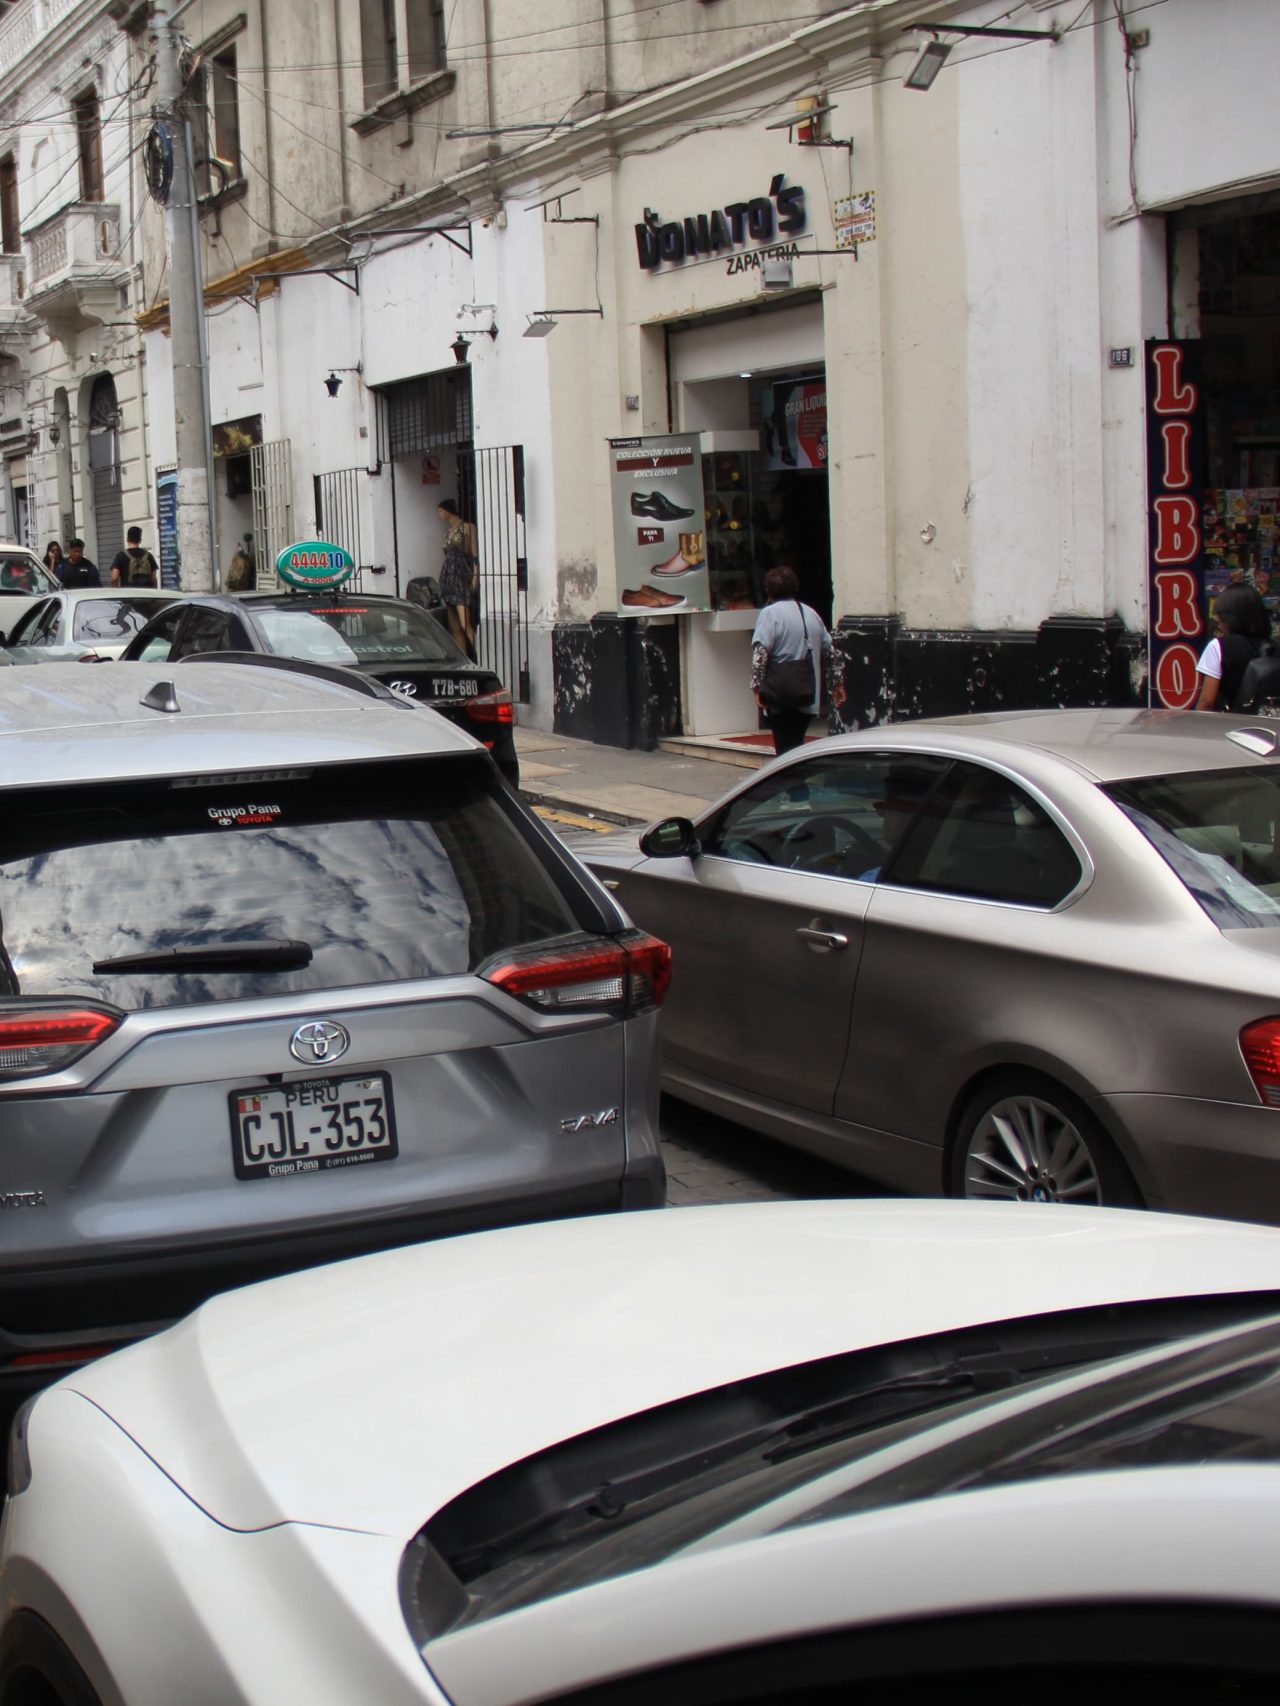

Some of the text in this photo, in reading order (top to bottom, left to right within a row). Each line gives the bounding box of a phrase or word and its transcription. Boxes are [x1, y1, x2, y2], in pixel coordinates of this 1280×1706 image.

[1112, 350, 1128, 361] 106
[663, 446, 692, 457] NUEVA
[652, 457, 659, 467] Y
[634, 468, 678, 478] EXCLUSIVA
[291, 551, 344, 569] 444410
[208, 804, 281, 819] Grupo Pana
[236, 815, 273, 824] TOYOTA
[303, 1080, 330, 1089] TOYOTA
[286, 1086, 339, 1108] PERU
[243, 1097, 386, 1162] CJL-353
[269, 1162, 295, 1176] Grupo
[297, 1159, 319, 1171] Pana
